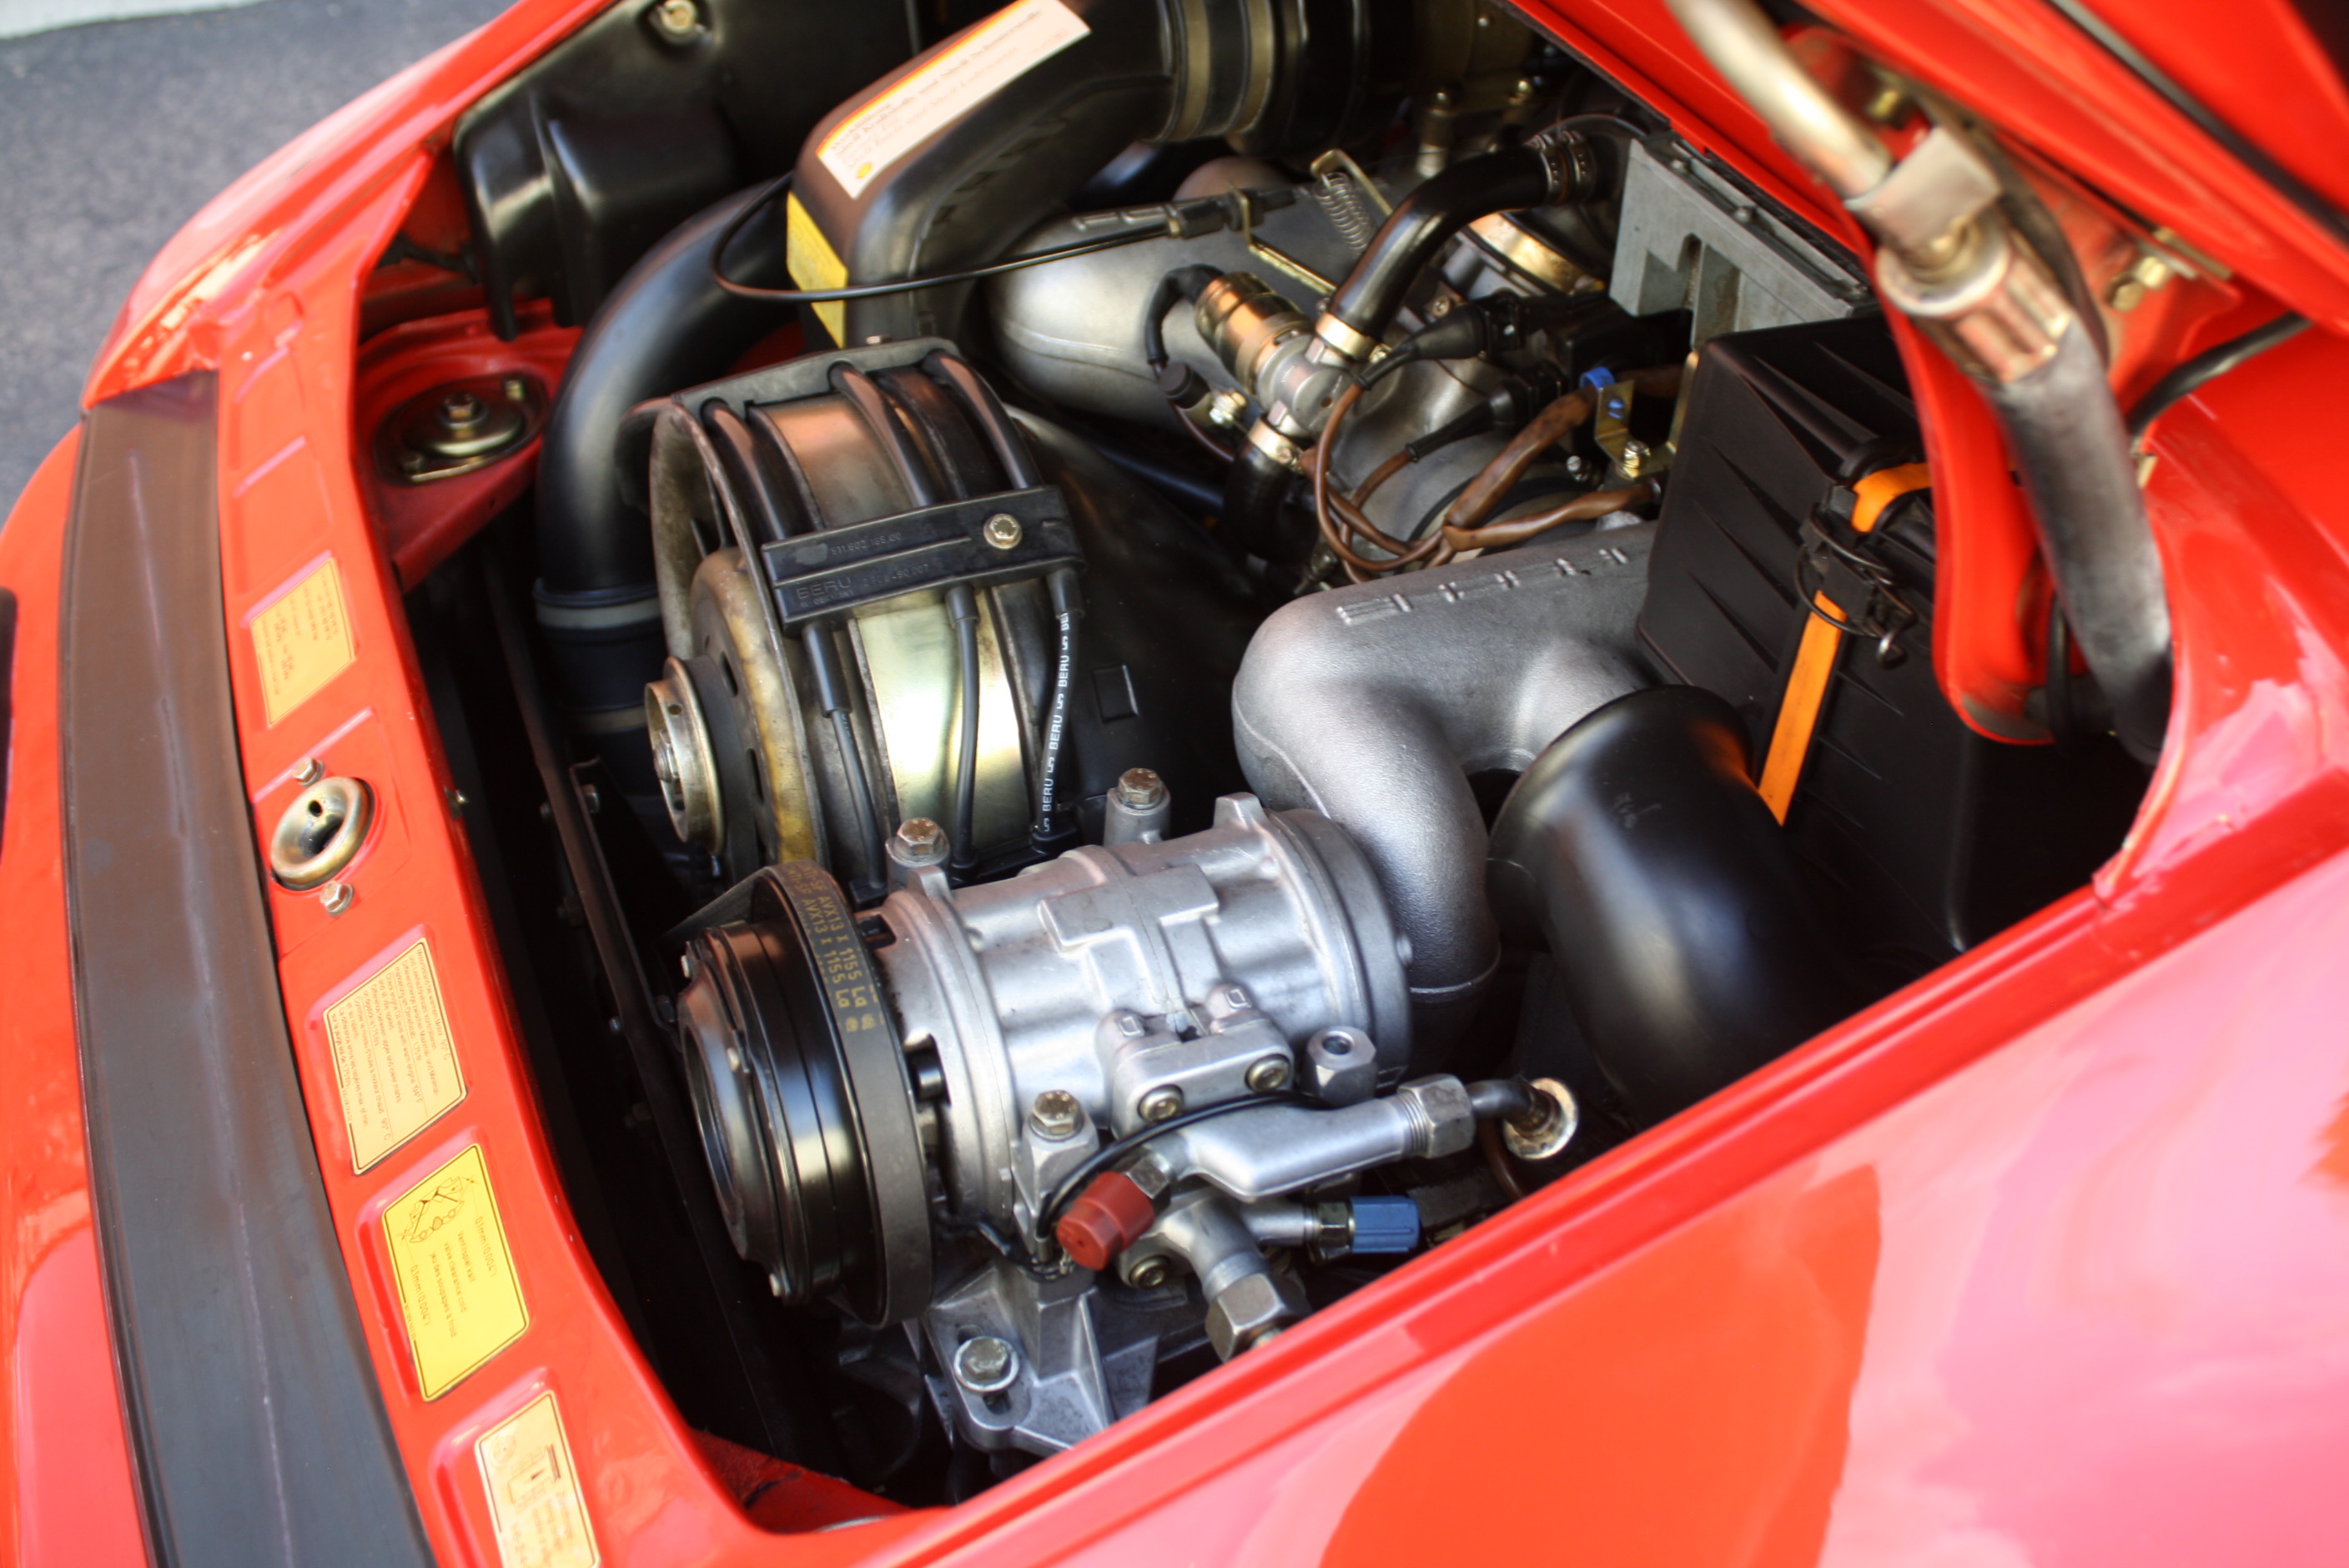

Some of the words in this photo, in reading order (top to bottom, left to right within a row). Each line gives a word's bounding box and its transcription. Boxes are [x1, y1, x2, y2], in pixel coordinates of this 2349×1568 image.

[797, 576, 852, 600] BERU
[1042, 778, 1054, 812] BERU
[1049, 714, 1063, 750] BERU
[1057, 655, 1070, 687] BERU
[802, 899, 829, 933] AVX13
[824, 951, 846, 983] 1155
[817, 896, 844, 931] AVX13
[839, 947, 863, 980] 1155
